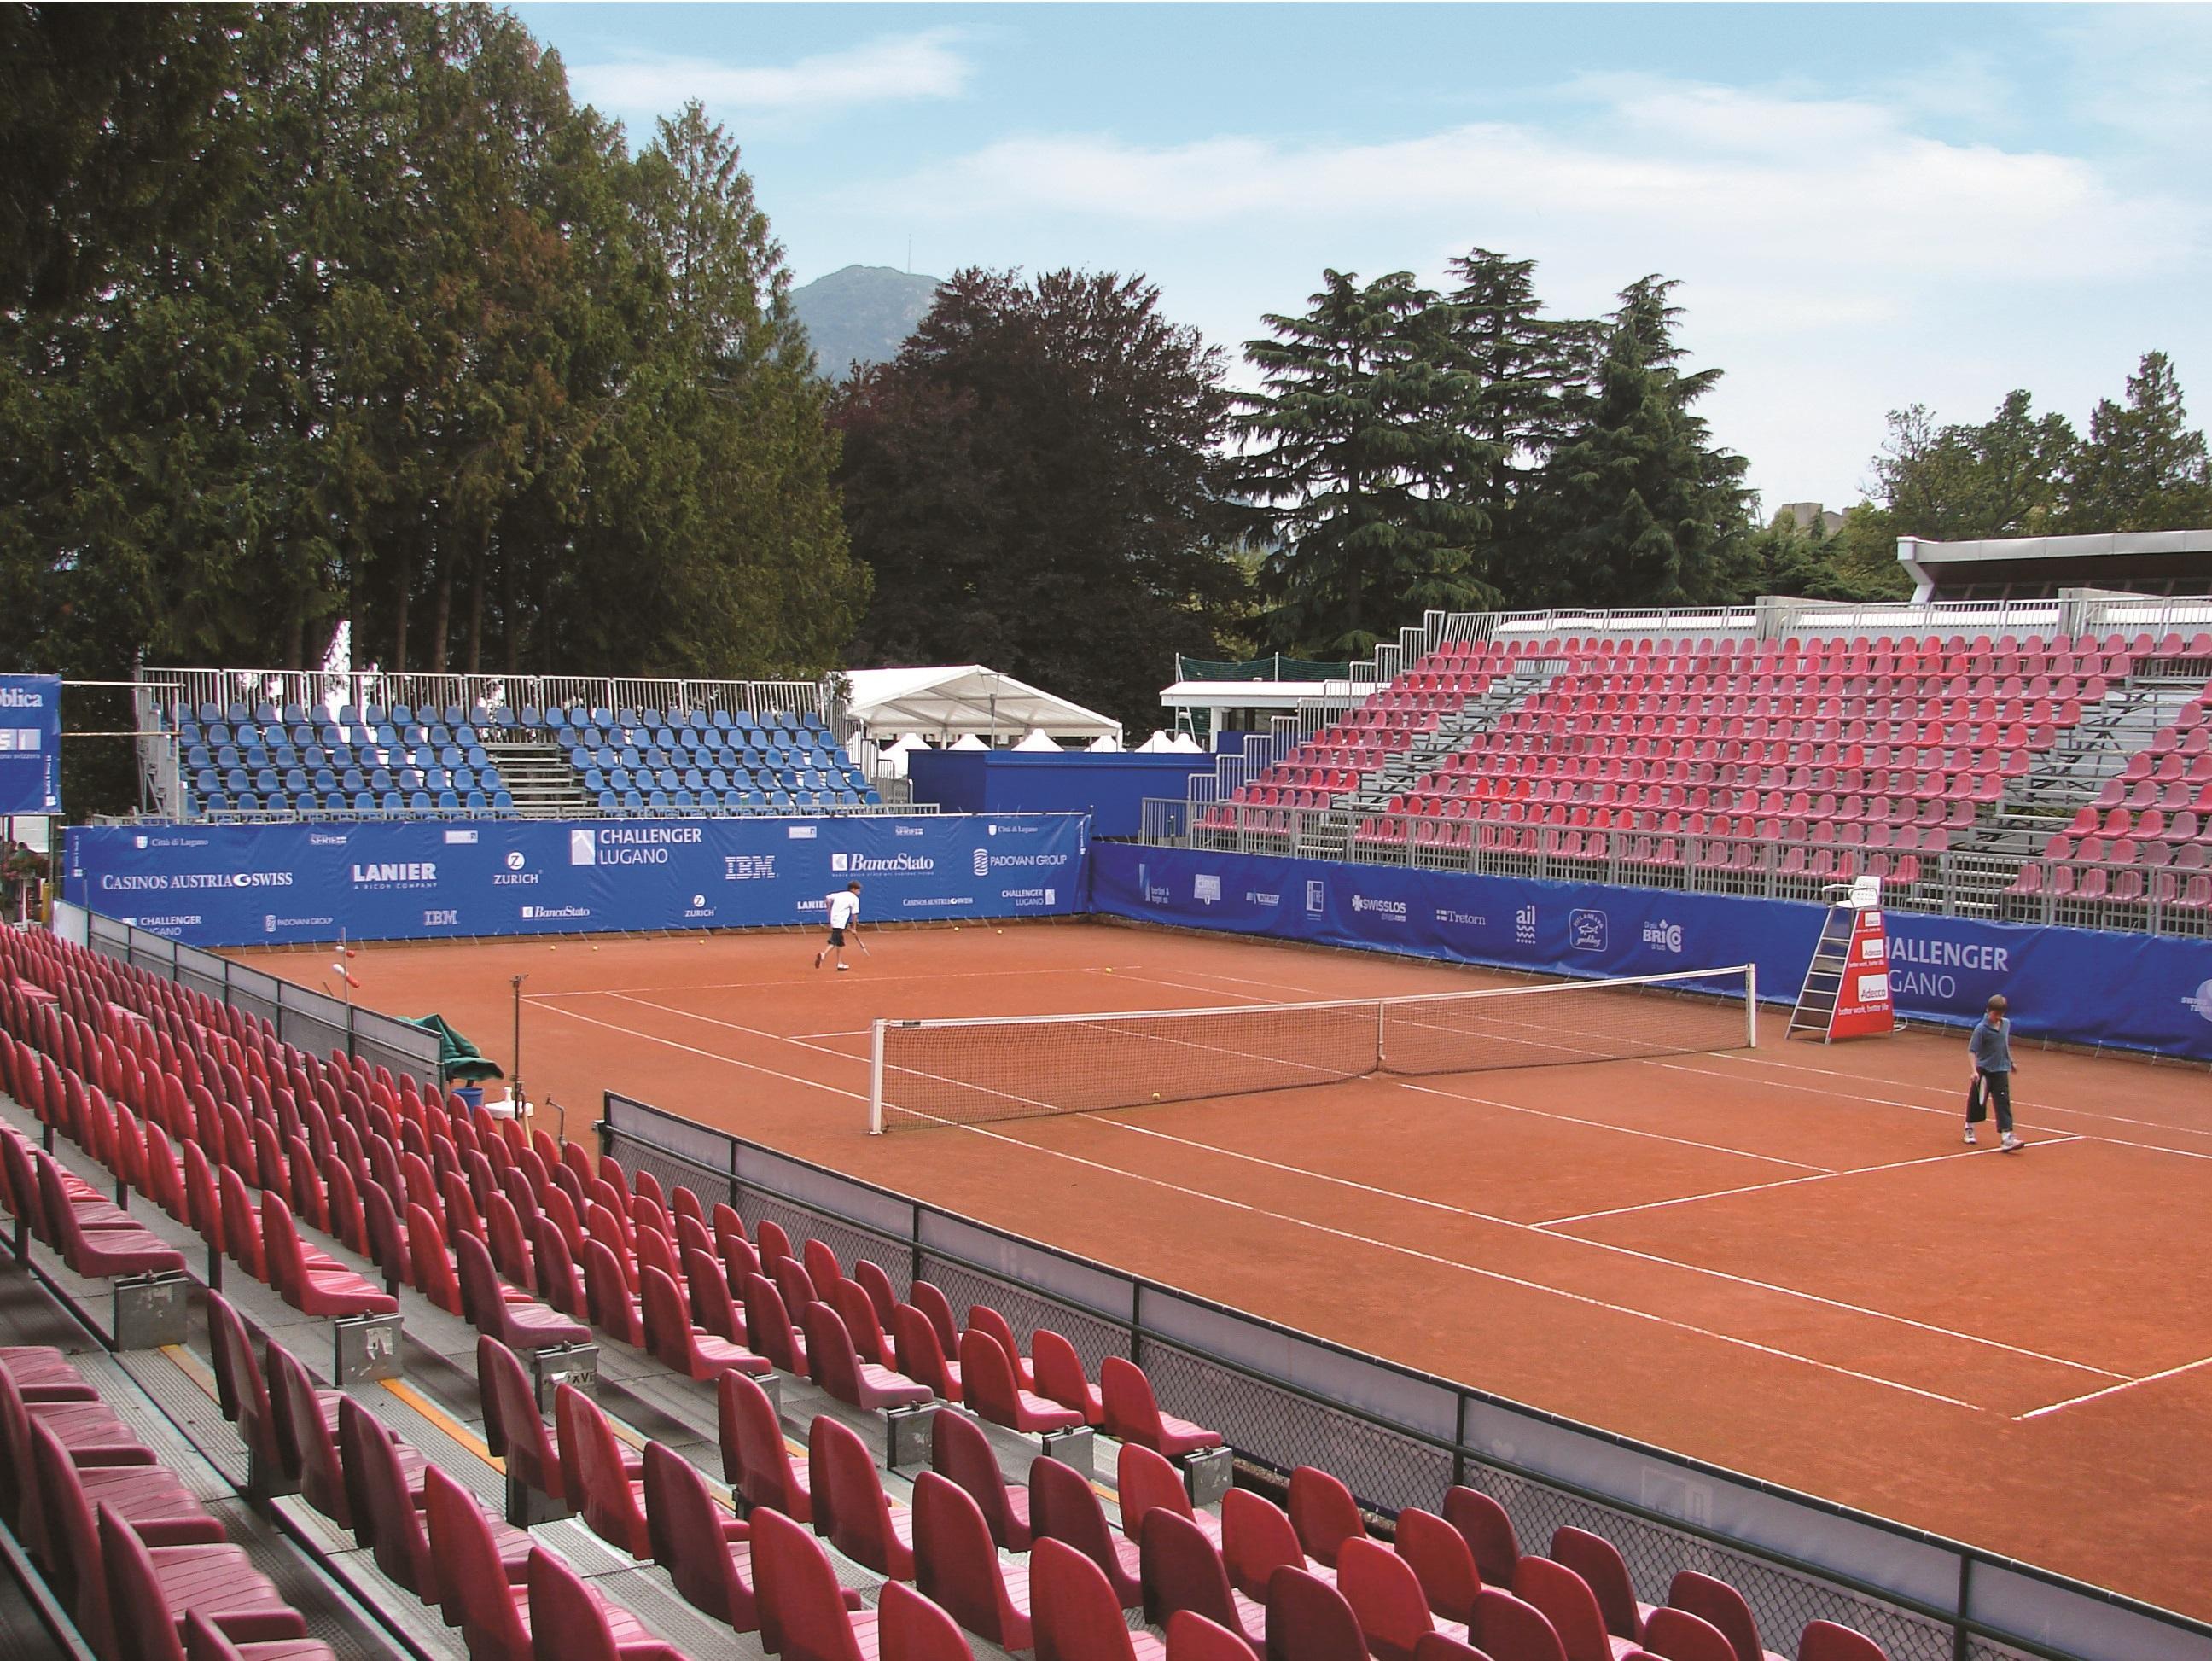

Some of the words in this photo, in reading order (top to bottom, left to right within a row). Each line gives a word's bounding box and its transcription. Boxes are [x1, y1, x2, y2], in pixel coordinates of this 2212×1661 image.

[0, 688, 43, 707] blica
[180, 839, 209, 848] Lugano
[600, 828, 702, 844] CHALLENGER
[600, 848, 668, 865] LUGANO
[850, 853, 934, 871] BancaStato
[990, 855, 1034, 866] PADOVANI
[1036, 854, 1067, 865] GROUP
[353, 863, 437, 882] LANIER
[725, 855, 776, 880] IBM
[102, 874, 168, 890] CASINOS
[493, 874, 538, 884] ZURICH
[534, 906, 591, 918] BancaStato
[798, 900, 827, 909] LANIE
[1362, 899, 1406, 913] SWISSLOS
[140, 916, 202, 925] CHALLENGER
[424, 910, 458, 926] IBM
[684, 909, 715, 918] ZURICH
[1447, 910, 1486, 925] Tretorn
[1516, 905, 1535, 925] ail
[277, 918, 310, 926] PADOVANI
[1885, 936, 2009, 971] ALLENGER
[1888, 969, 1956, 999] GANO
[1860, 987, 1886, 1000] Adecco
[1867, 1004, 1880, 1012] better
